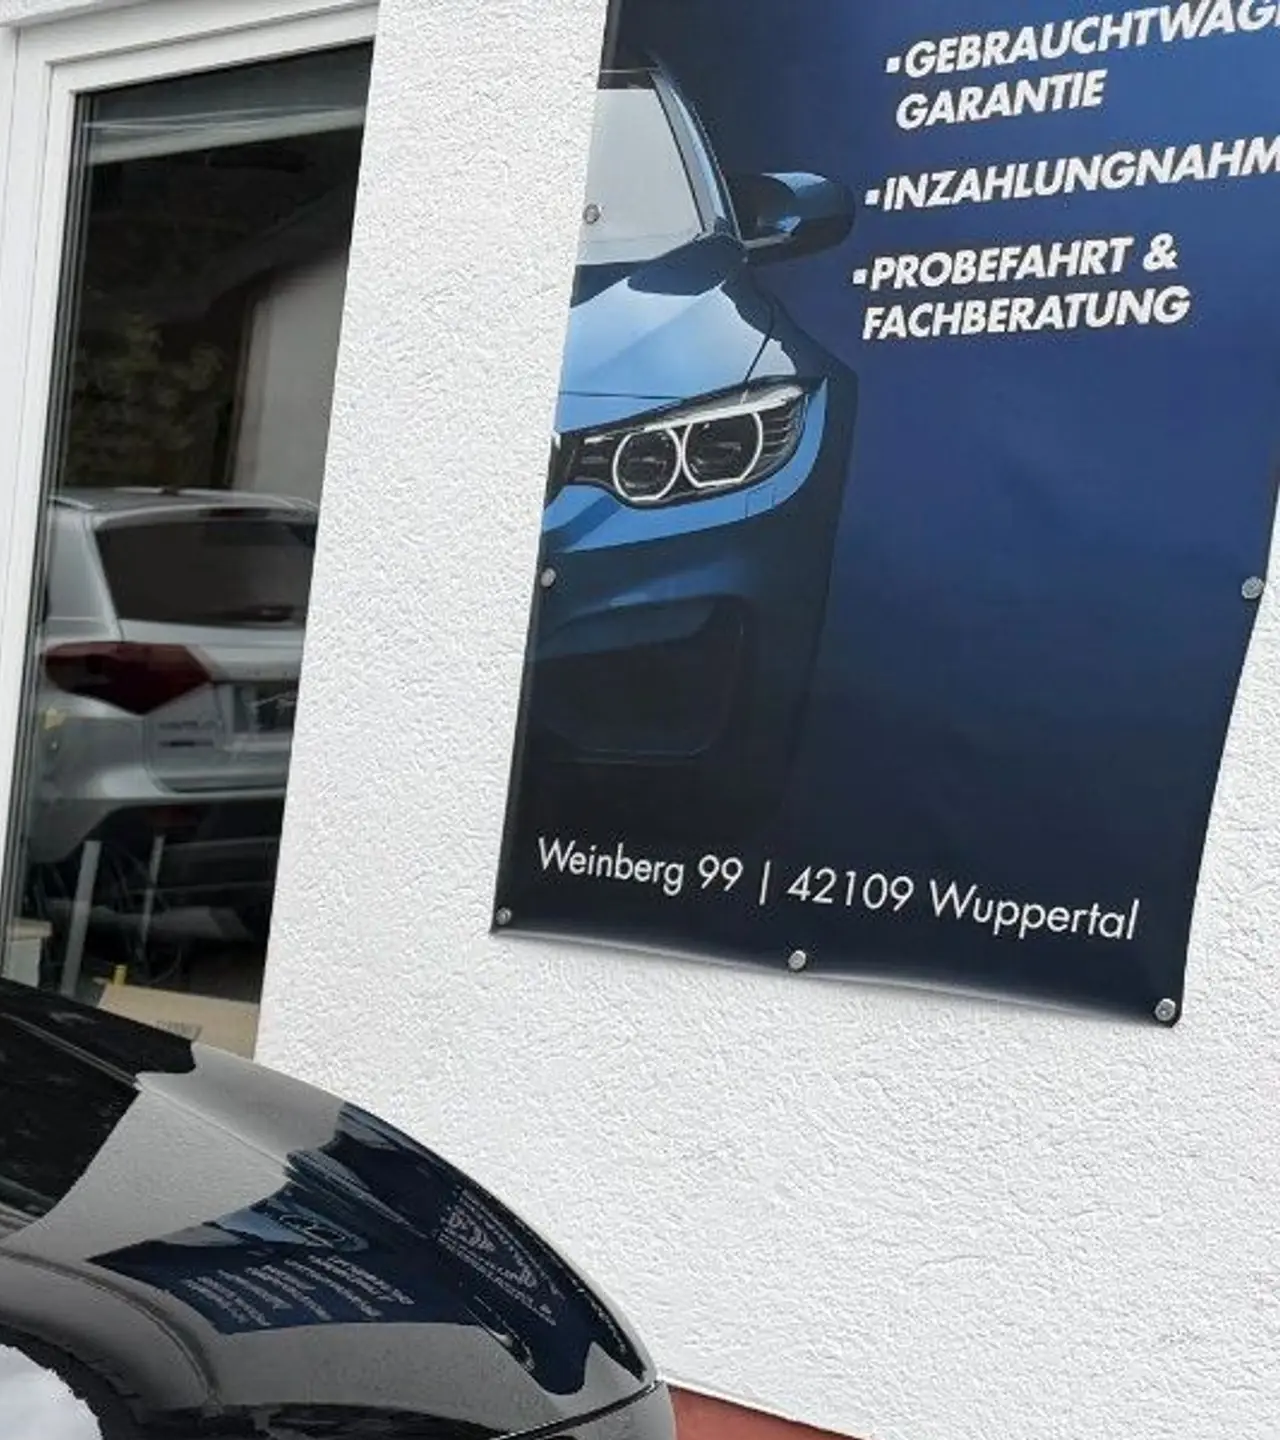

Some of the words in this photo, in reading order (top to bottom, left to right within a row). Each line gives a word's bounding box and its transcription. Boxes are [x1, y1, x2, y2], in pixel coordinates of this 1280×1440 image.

[905, 0, 1280, 78] GEBRAUCHTWAG
[896, 68, 1108, 130] GARANTIE
[870, 237, 1134, 291] PROBEFAHRT
[1142, 233, 1178, 272] &
[862, 285, 1190, 340] FACHBERATUNG
[538, 836, 684, 896] Weinberg
[698, 855, 743, 892] 99
[787, 866, 914, 912] 42109
[930, 878, 1139, 940] Wuppertal
